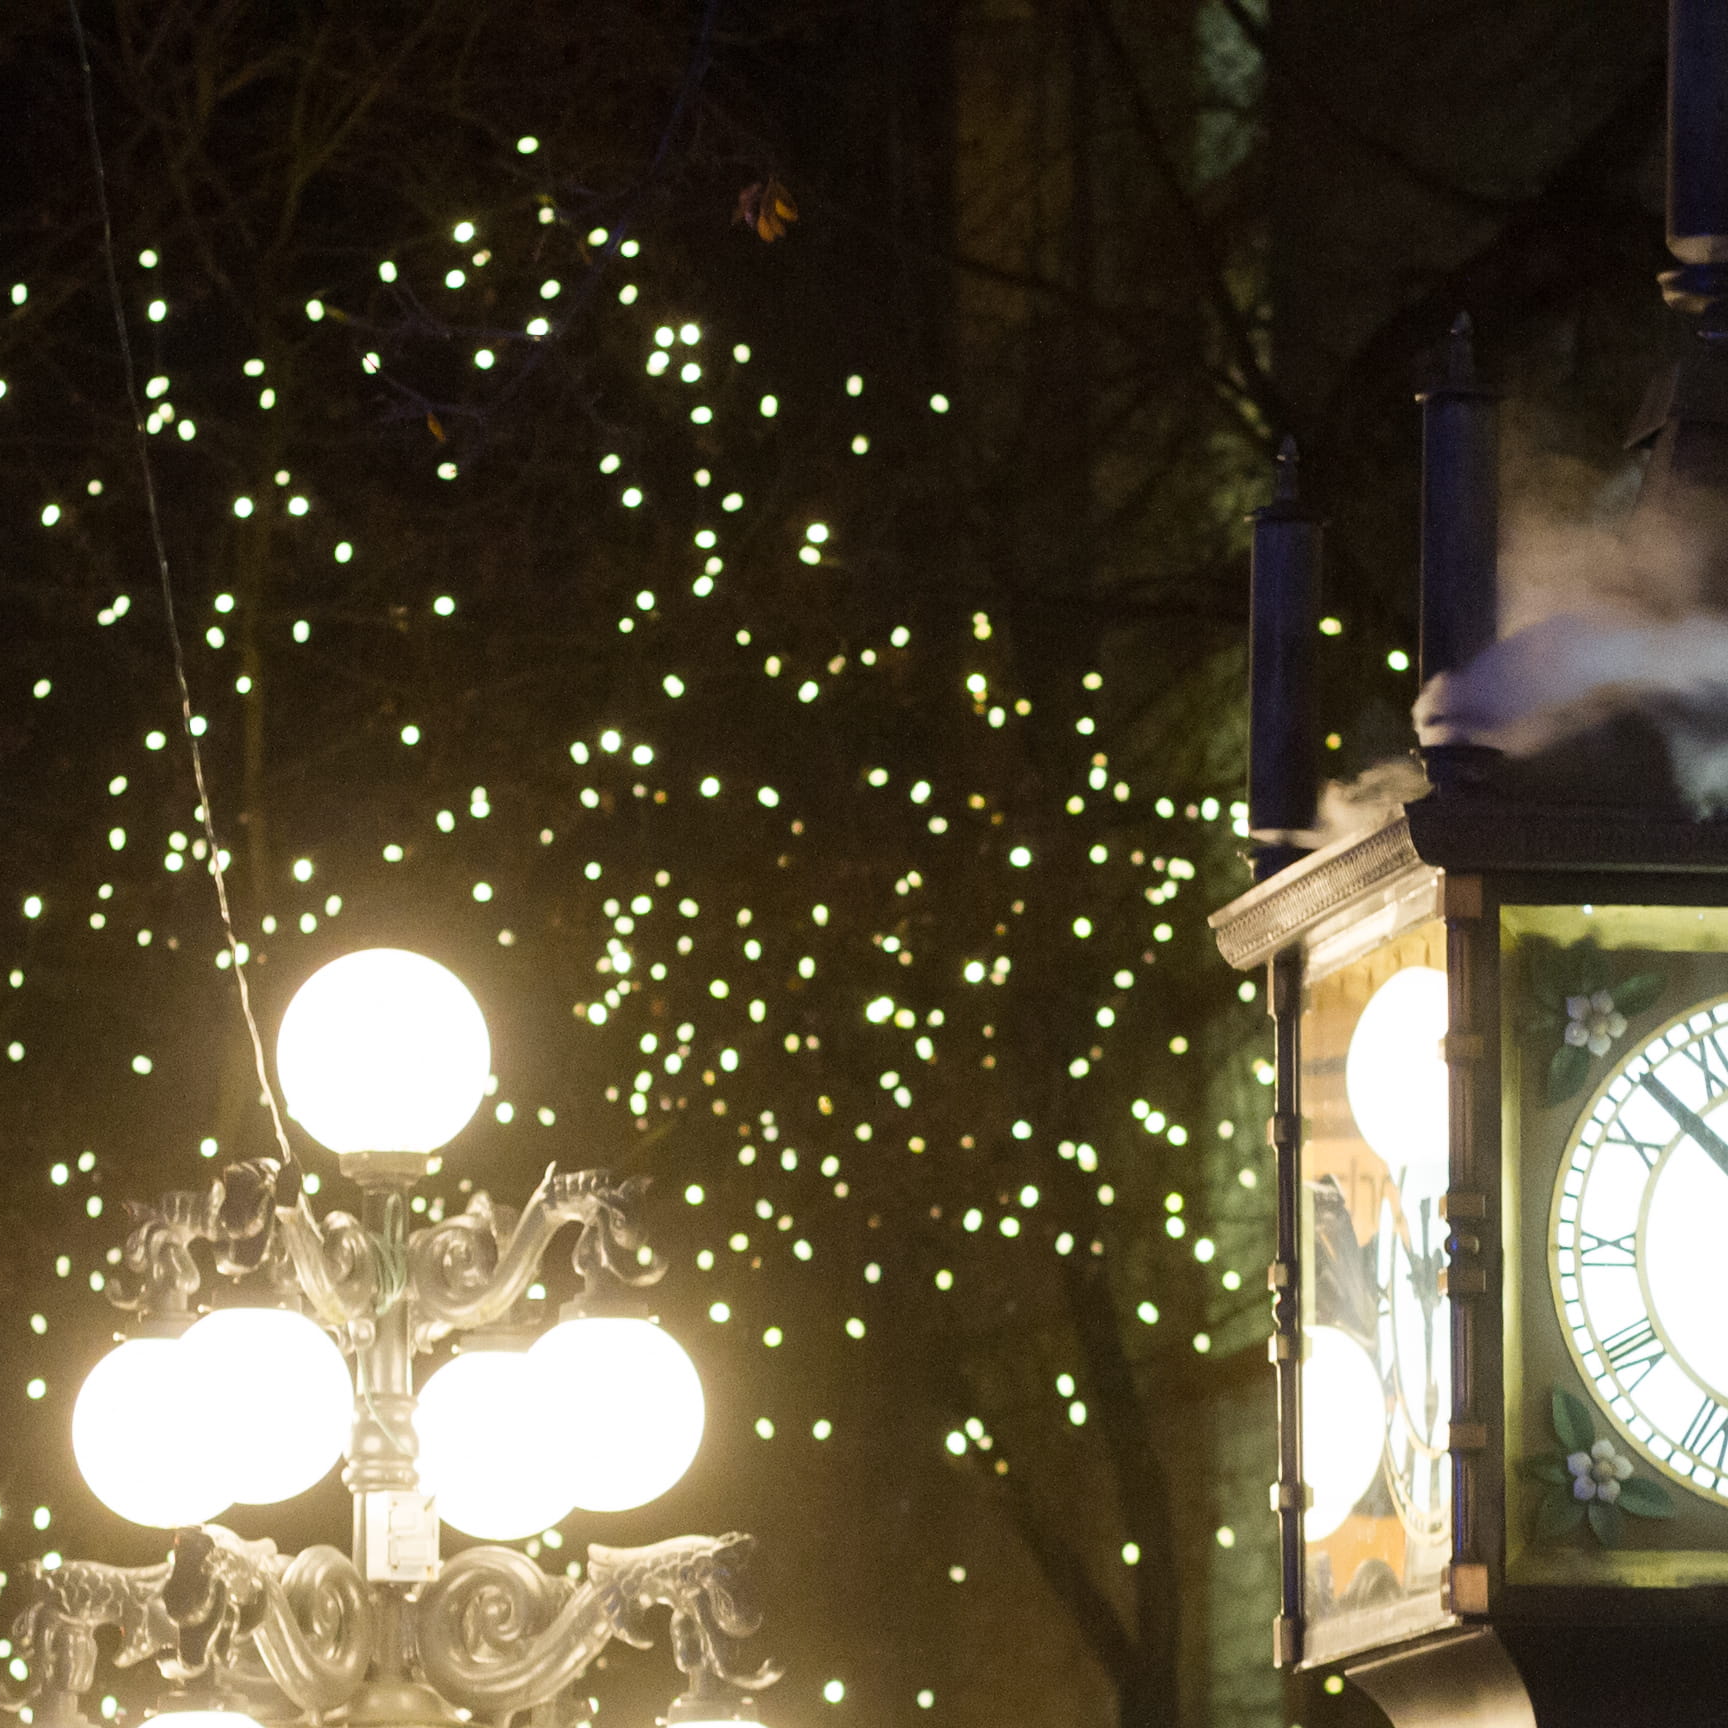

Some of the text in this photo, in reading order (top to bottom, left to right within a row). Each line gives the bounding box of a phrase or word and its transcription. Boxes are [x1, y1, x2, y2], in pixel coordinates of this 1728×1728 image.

[1604, 1117, 1668, 1169] X
[1580, 1231, 1636, 1267] IX
[1599, 1317, 1666, 1392] VIII
